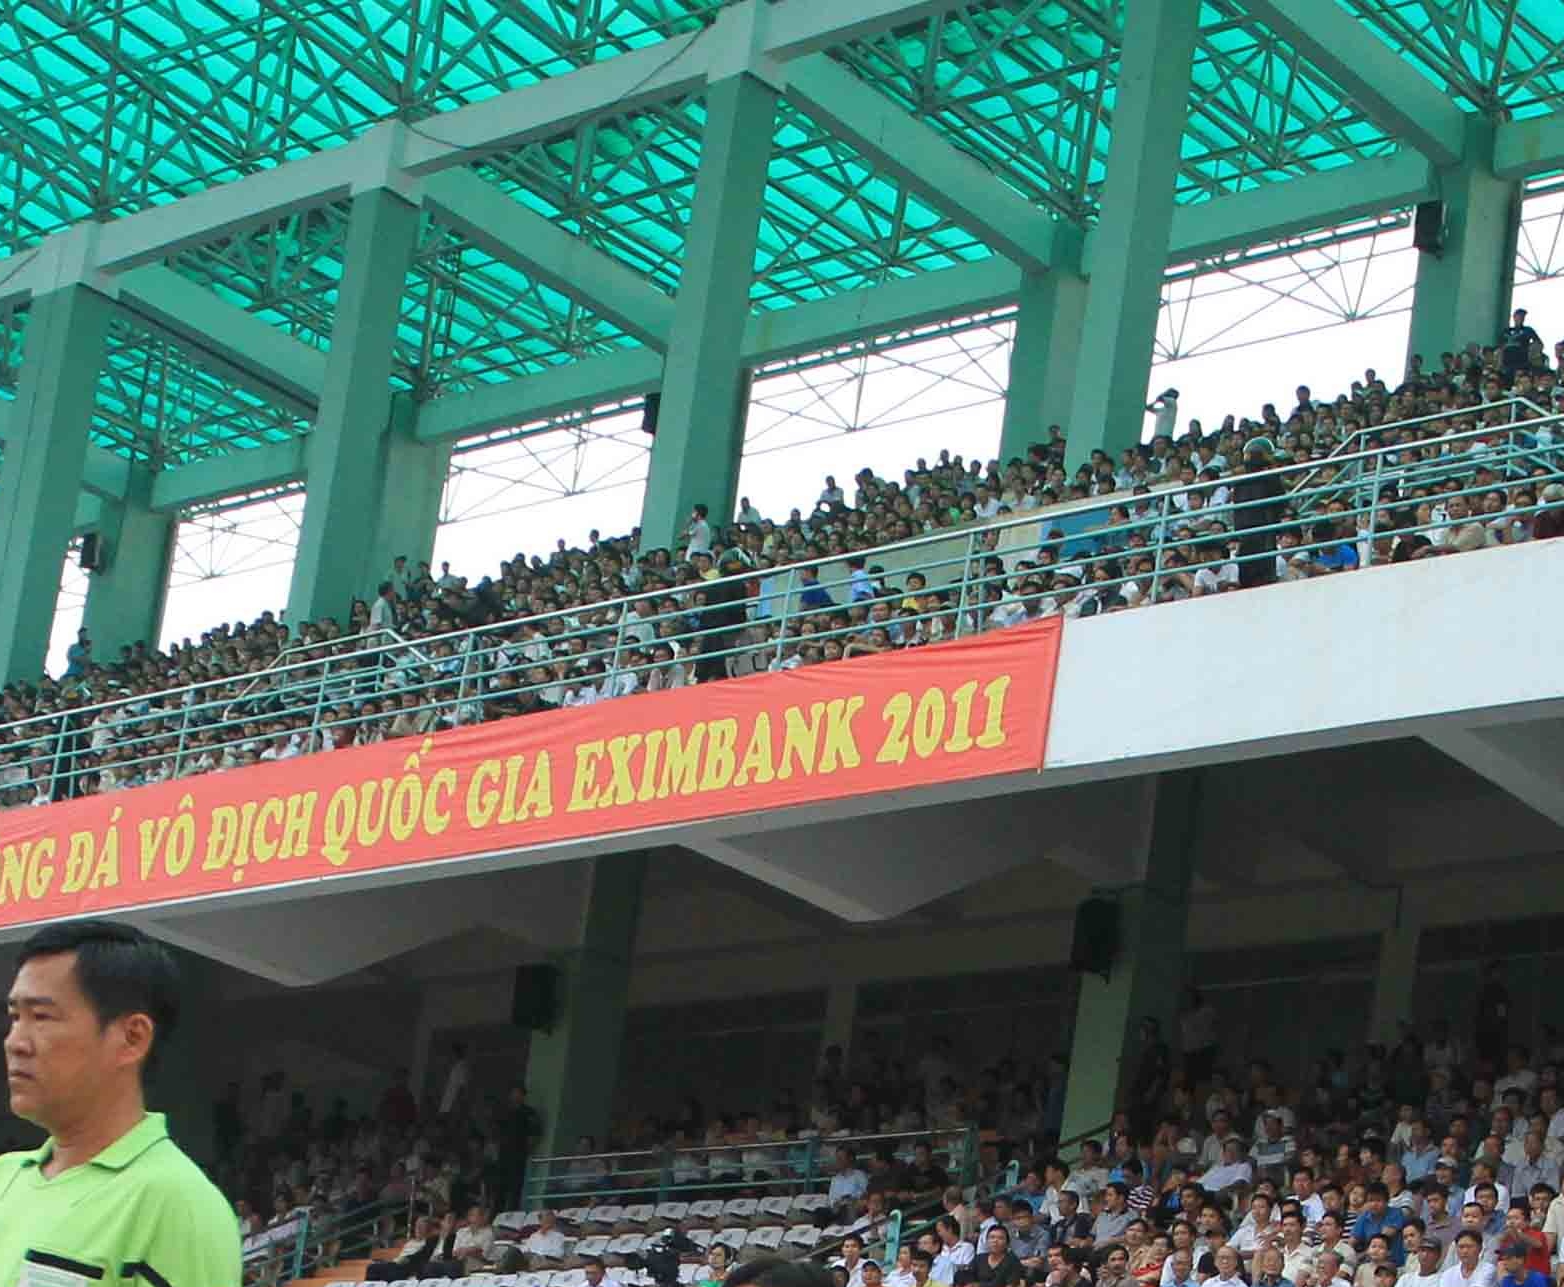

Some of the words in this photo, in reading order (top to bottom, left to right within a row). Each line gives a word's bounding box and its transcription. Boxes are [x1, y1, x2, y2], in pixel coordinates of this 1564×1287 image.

[61, 806, 123, 894] ĐÁ
[137, 794, 196, 881] VÔ
[202, 791, 318, 883] ĐỊCH
[322, 737, 458, 866] QUỐC
[466, 750, 554, 829] GIA
[566, 695, 864, 812] EXIMBANK
[876, 675, 1011, 767] 2011
